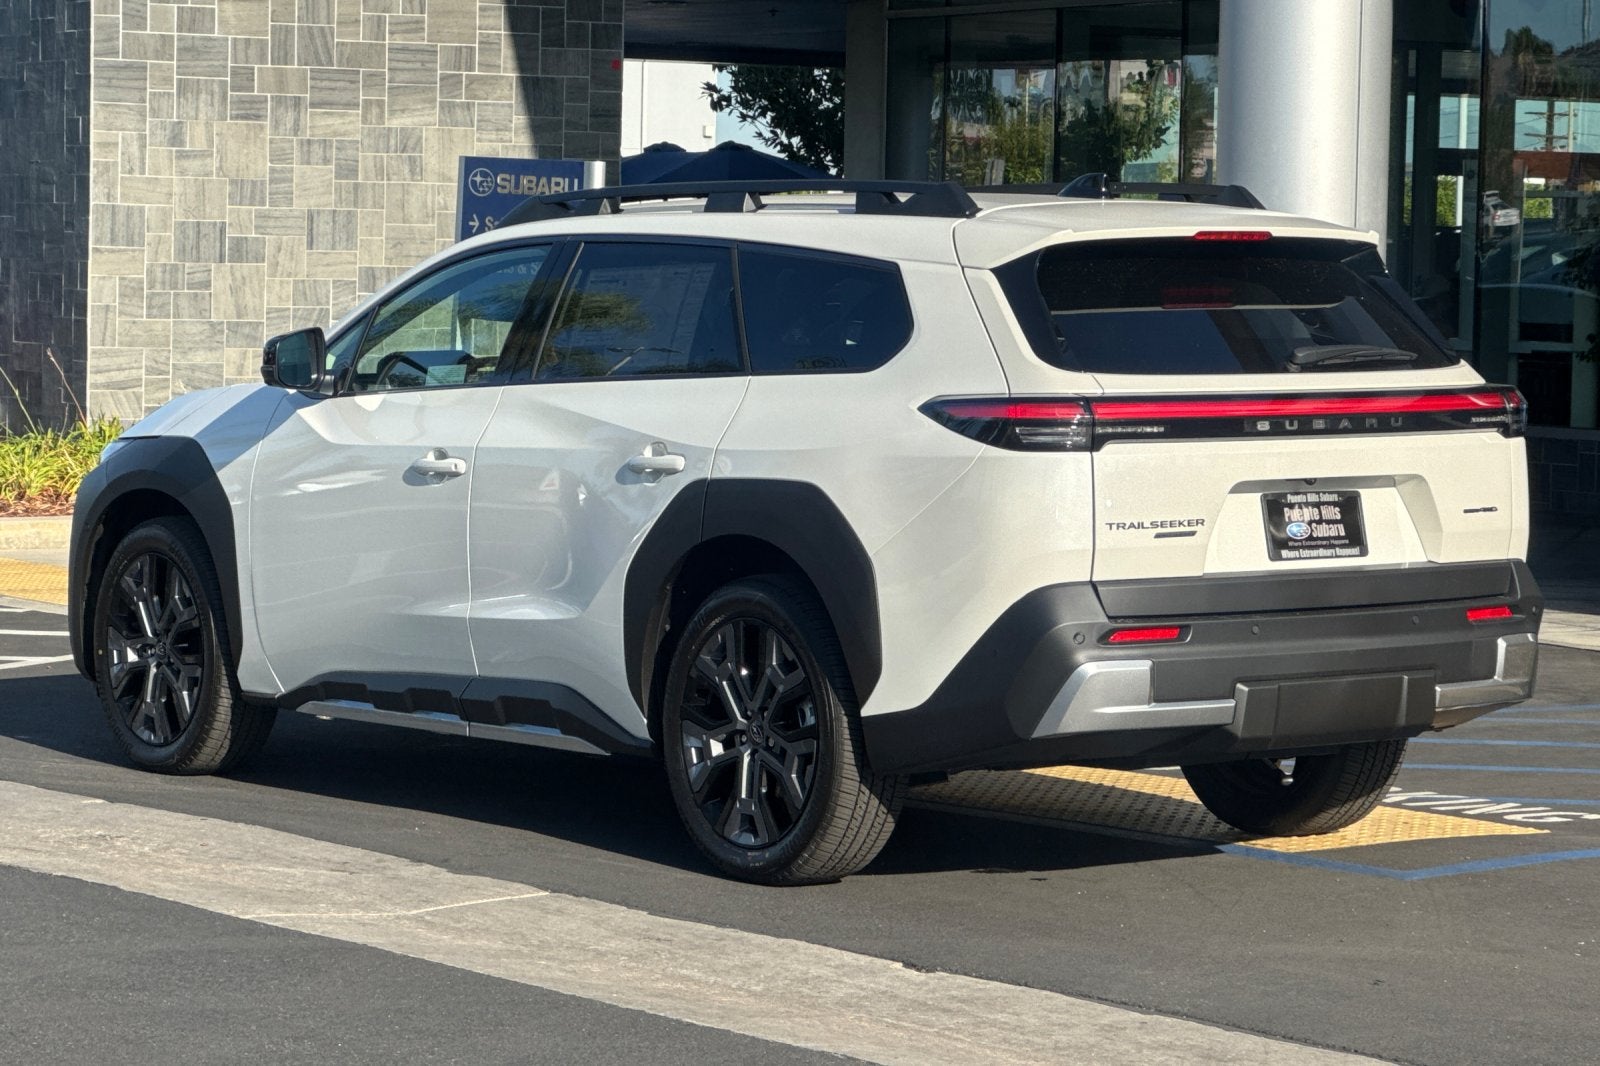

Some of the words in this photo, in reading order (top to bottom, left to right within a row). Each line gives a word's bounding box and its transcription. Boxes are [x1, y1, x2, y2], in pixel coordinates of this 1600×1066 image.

[496, 173, 579, 196] SUBARU
[1256, 416, 1403, 432] SUBARU
[1283, 506, 1320, 522] Puente
[1320, 504, 1341, 520] Hills
[1105, 518, 1206, 531] TRAILSEEKER
[1311, 522, 1345, 537] Subaru
[1280, 549, 1300, 559] Where
